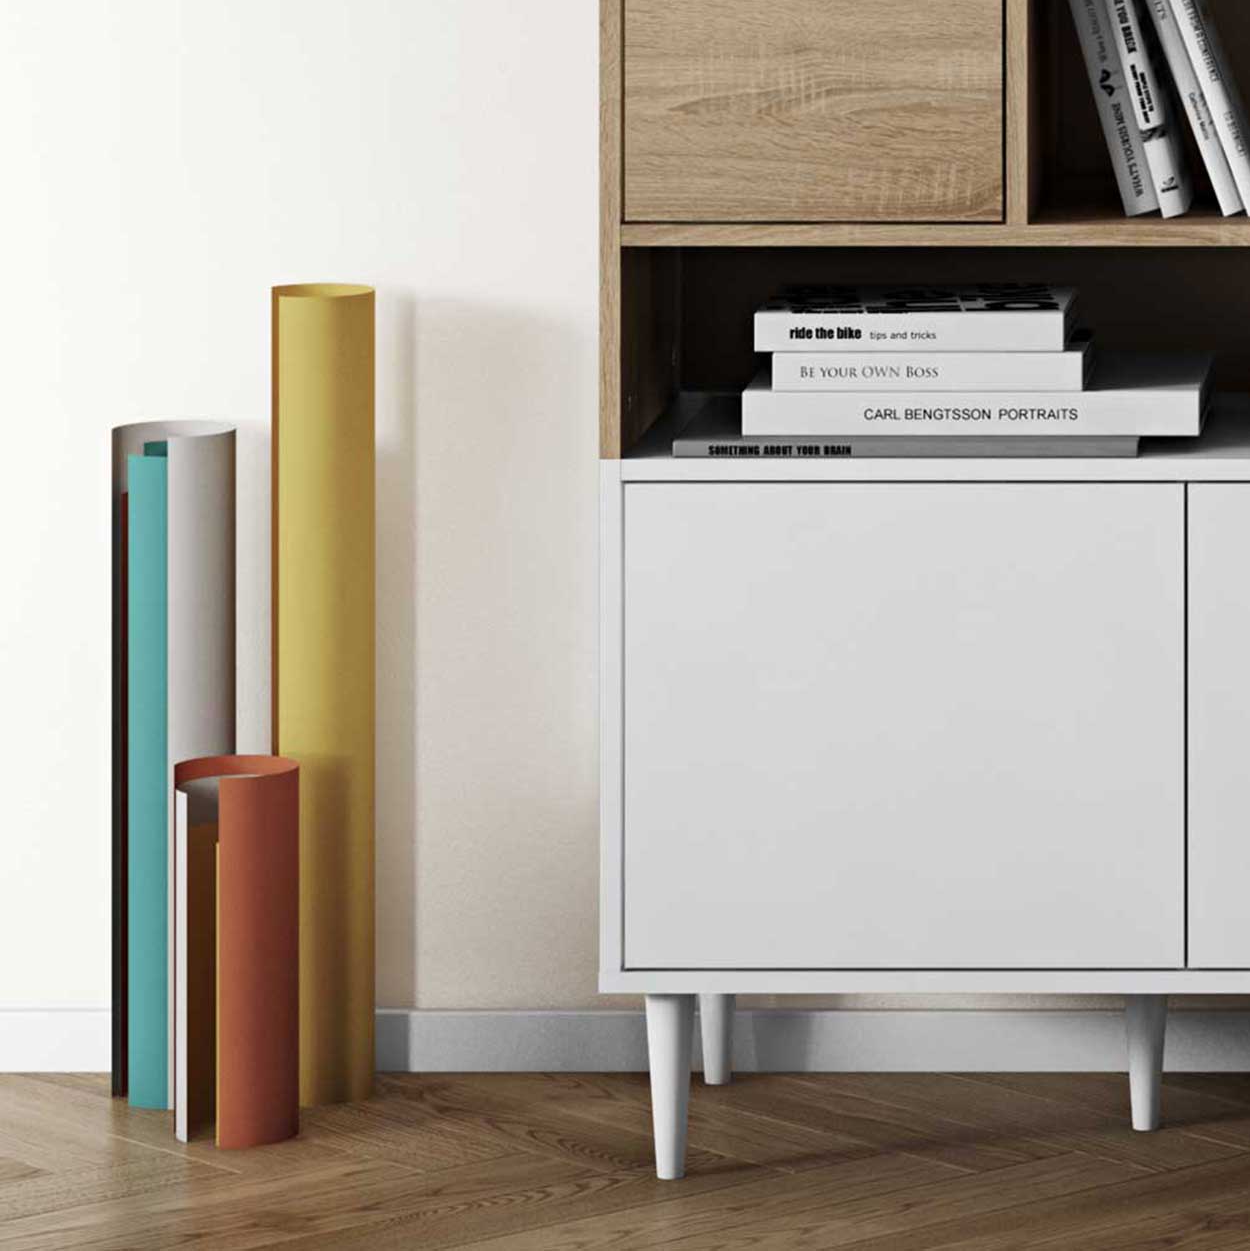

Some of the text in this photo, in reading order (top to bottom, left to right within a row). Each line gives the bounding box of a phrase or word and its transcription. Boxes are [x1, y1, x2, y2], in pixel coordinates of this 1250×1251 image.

[1116, 4, 1130, 24] YOU
[789, 327, 937, 342] ride the bike tips and tricks
[861, 366, 901, 378] OWN
[863, 408, 1079, 421] CARL BENGTSSON PORTRAITS
[708, 445, 852, 456] SOMETHING ABOUT YOUR BRAIN
